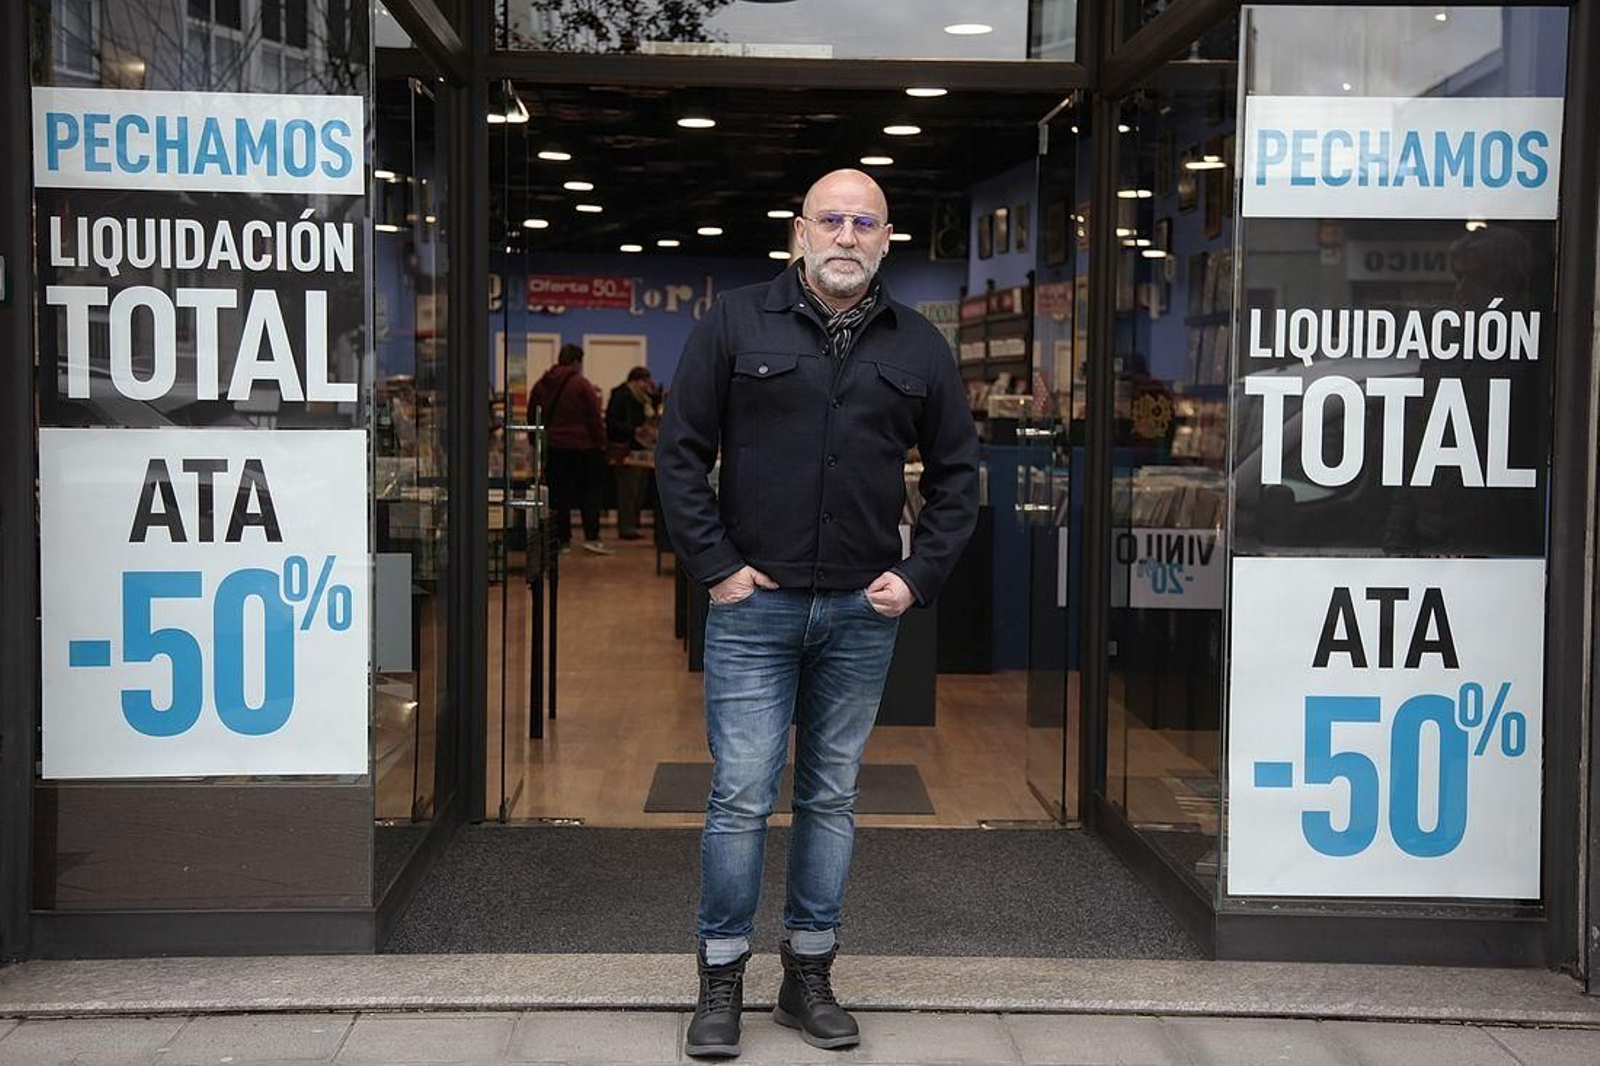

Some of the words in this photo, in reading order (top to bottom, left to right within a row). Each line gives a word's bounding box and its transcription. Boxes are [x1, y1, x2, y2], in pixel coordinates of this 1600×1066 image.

[45, 111, 353, 180] PECHAMOS
[1255, 128, 1549, 189] PECHAMOS
[50, 208, 354, 277] LIQUIDACIÓN
[529, 278, 590, 294] Oferta
[45, 285, 358, 403] TOTAL
[1249, 297, 1541, 367] LIQUIDACIÓN
[1244, 374, 1537, 488] TOTAL
[128, 458, 283, 543] ATA
[68, 554, 353, 738] -50%
[1311, 586, 1461, 670] ATA
[1253, 681, 1527, 859] -50%
